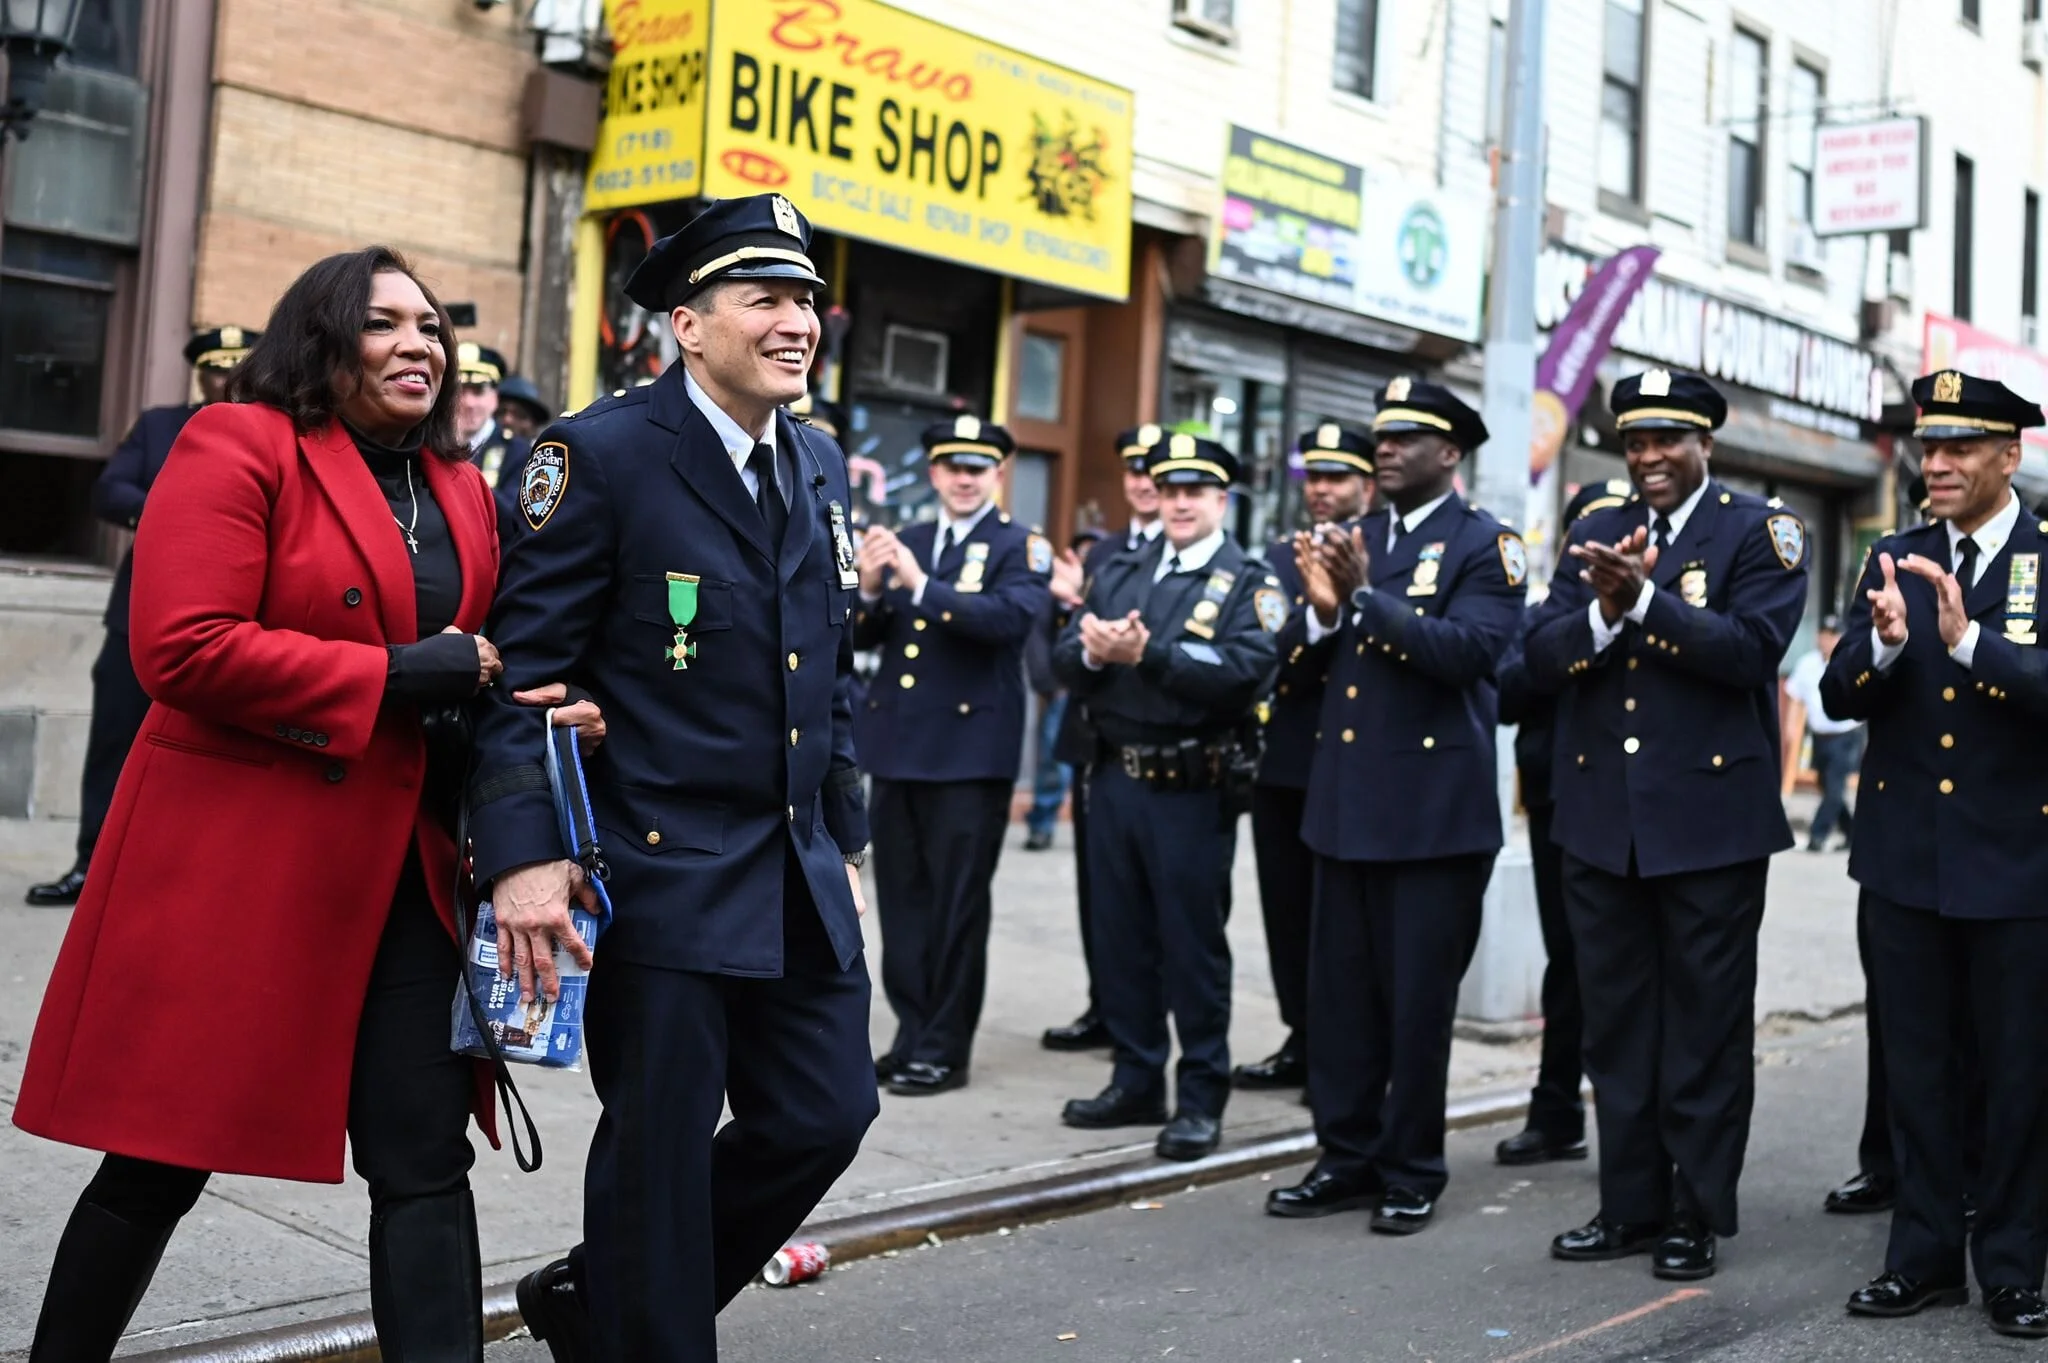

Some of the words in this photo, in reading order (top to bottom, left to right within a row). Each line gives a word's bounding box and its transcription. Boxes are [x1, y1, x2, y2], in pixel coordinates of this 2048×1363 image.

[769, 0, 974, 102] Bravo
[650, 50, 706, 111] SHOP
[615, 128, 672, 160] (718)
[729, 50, 856, 163] BIKE
[875, 96, 1003, 200] SHOP
[526, 456, 564, 477] DEPARTMENT
[533, 447, 554, 459] POLICE
[540, 498, 554, 518] NEW
[551, 472, 565, 497] YORK
[488, 983, 500, 1009] FOUR
